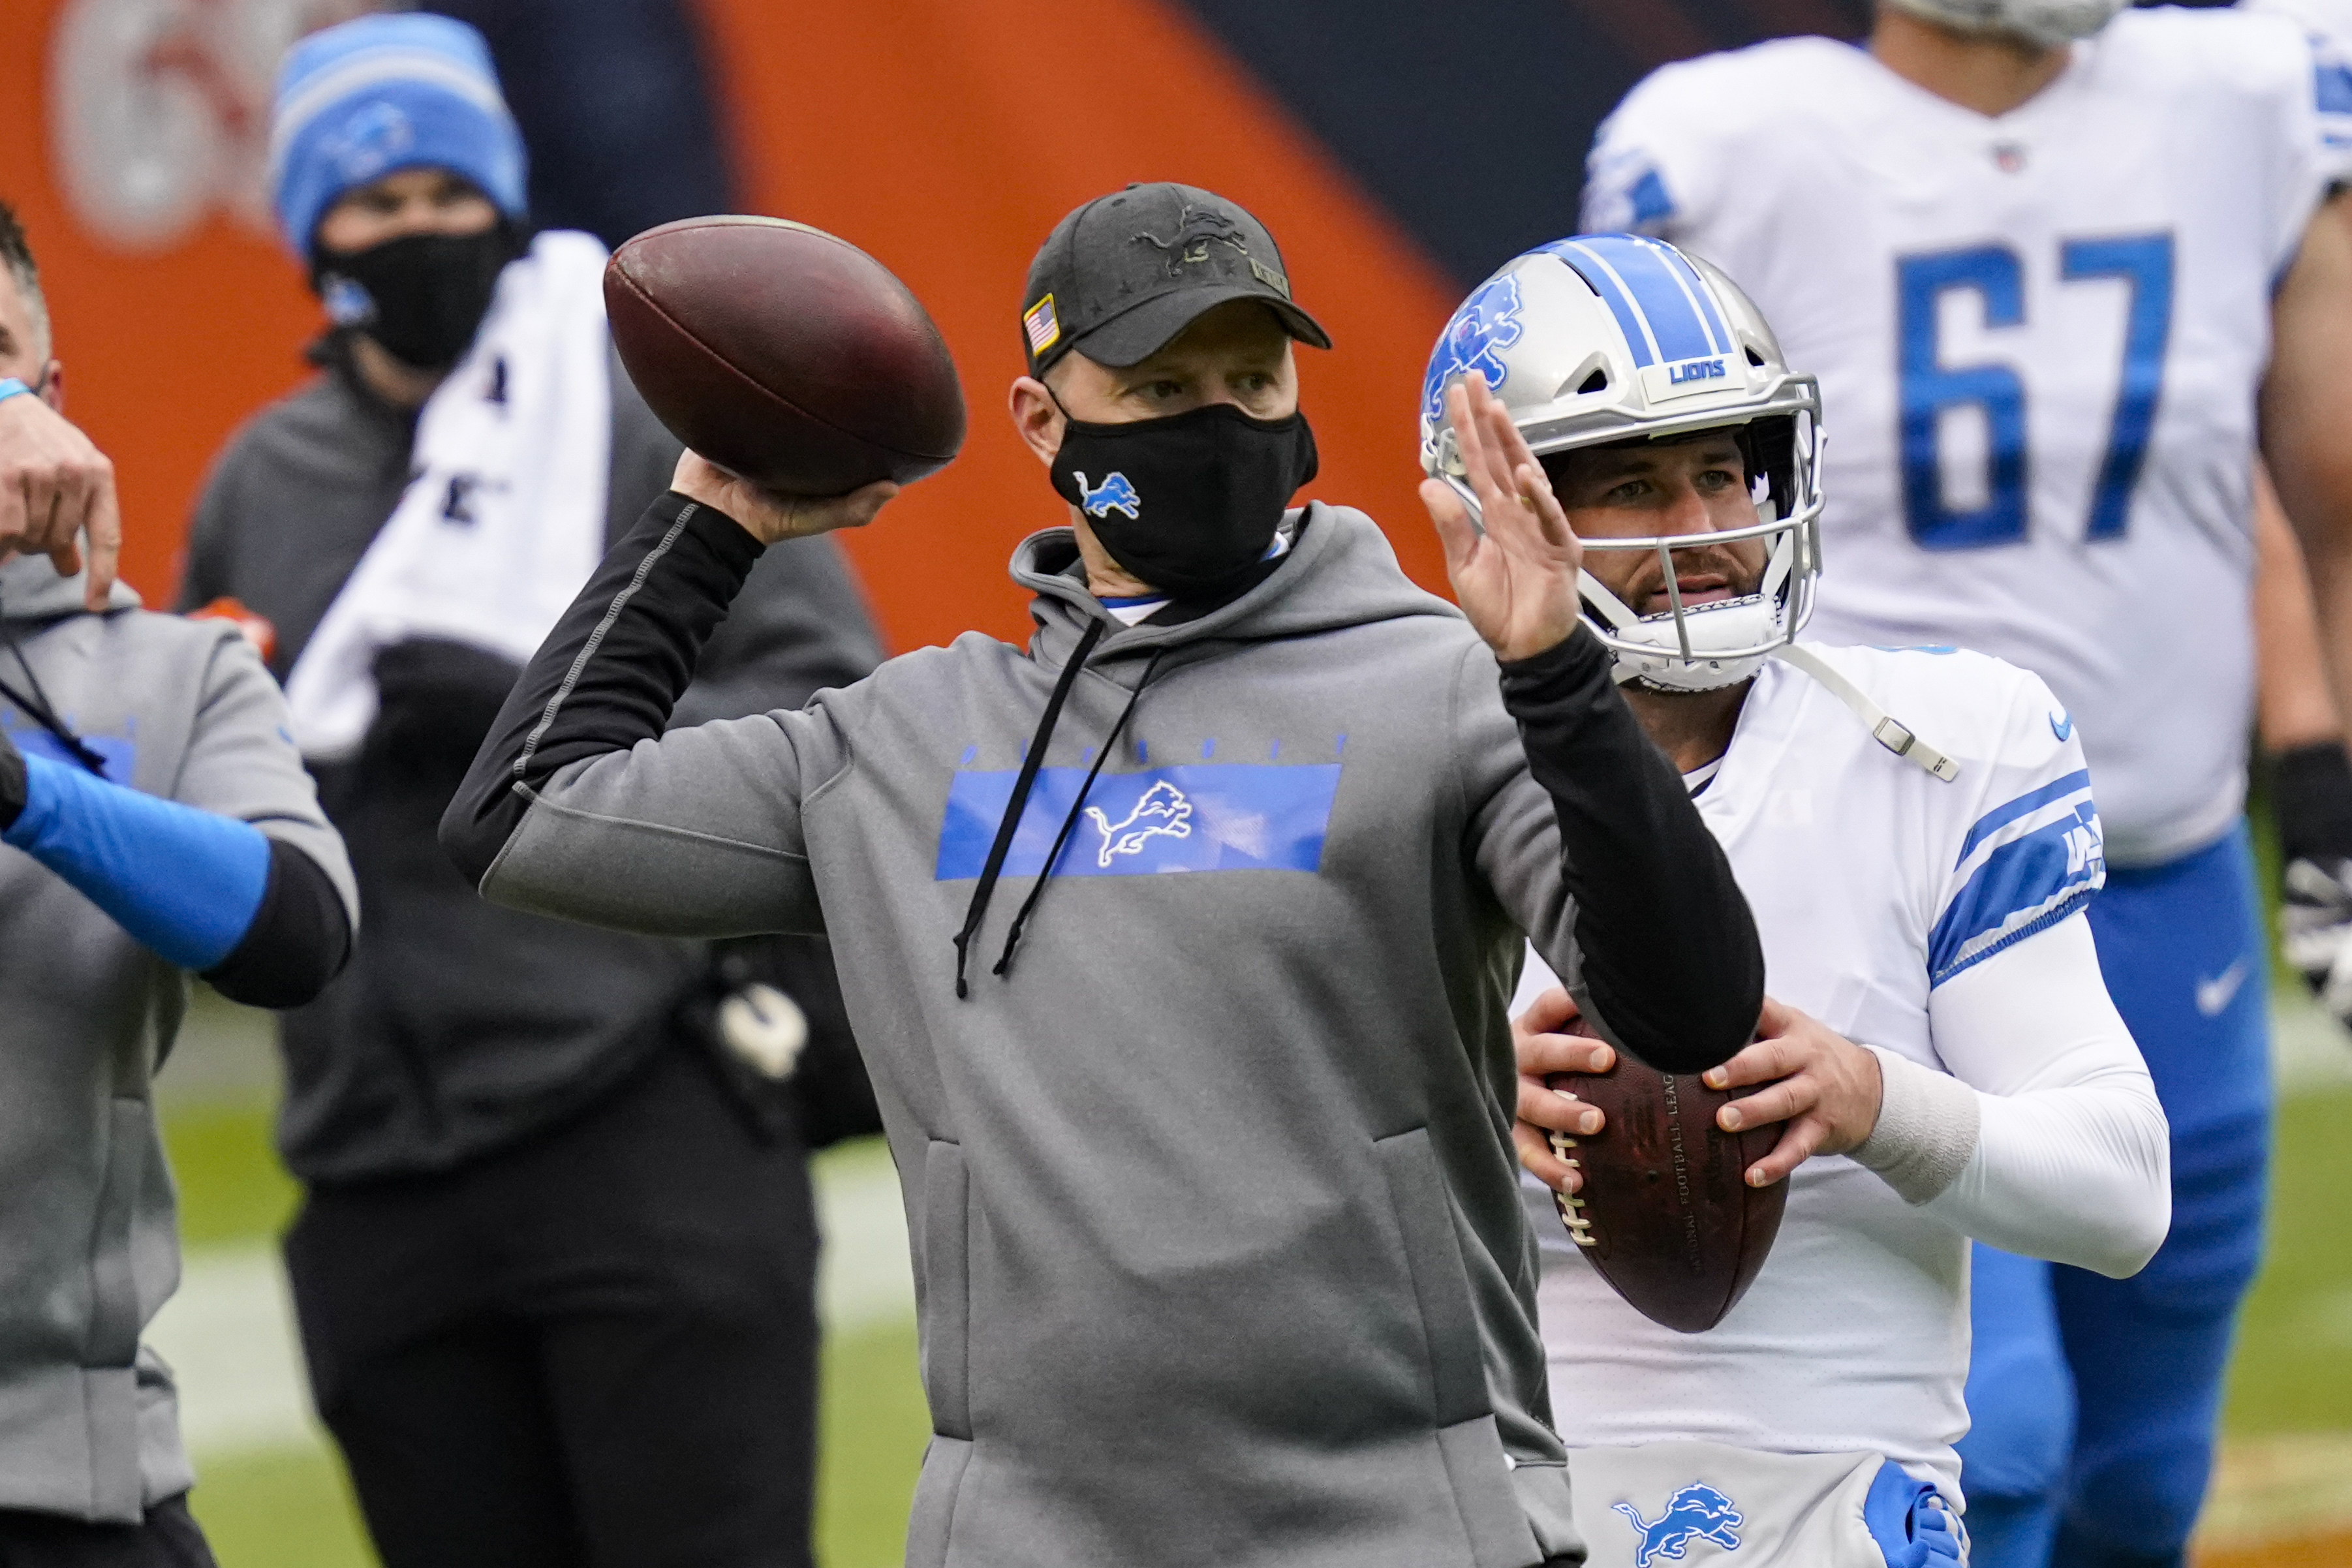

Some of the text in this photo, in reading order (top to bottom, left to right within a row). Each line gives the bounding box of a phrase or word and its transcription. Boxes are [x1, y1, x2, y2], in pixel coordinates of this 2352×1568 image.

[1669, 360, 1725, 384] LIONS
[1895, 230, 2175, 551] 67
[1668, 1121, 1689, 1205] FOOTBALL
